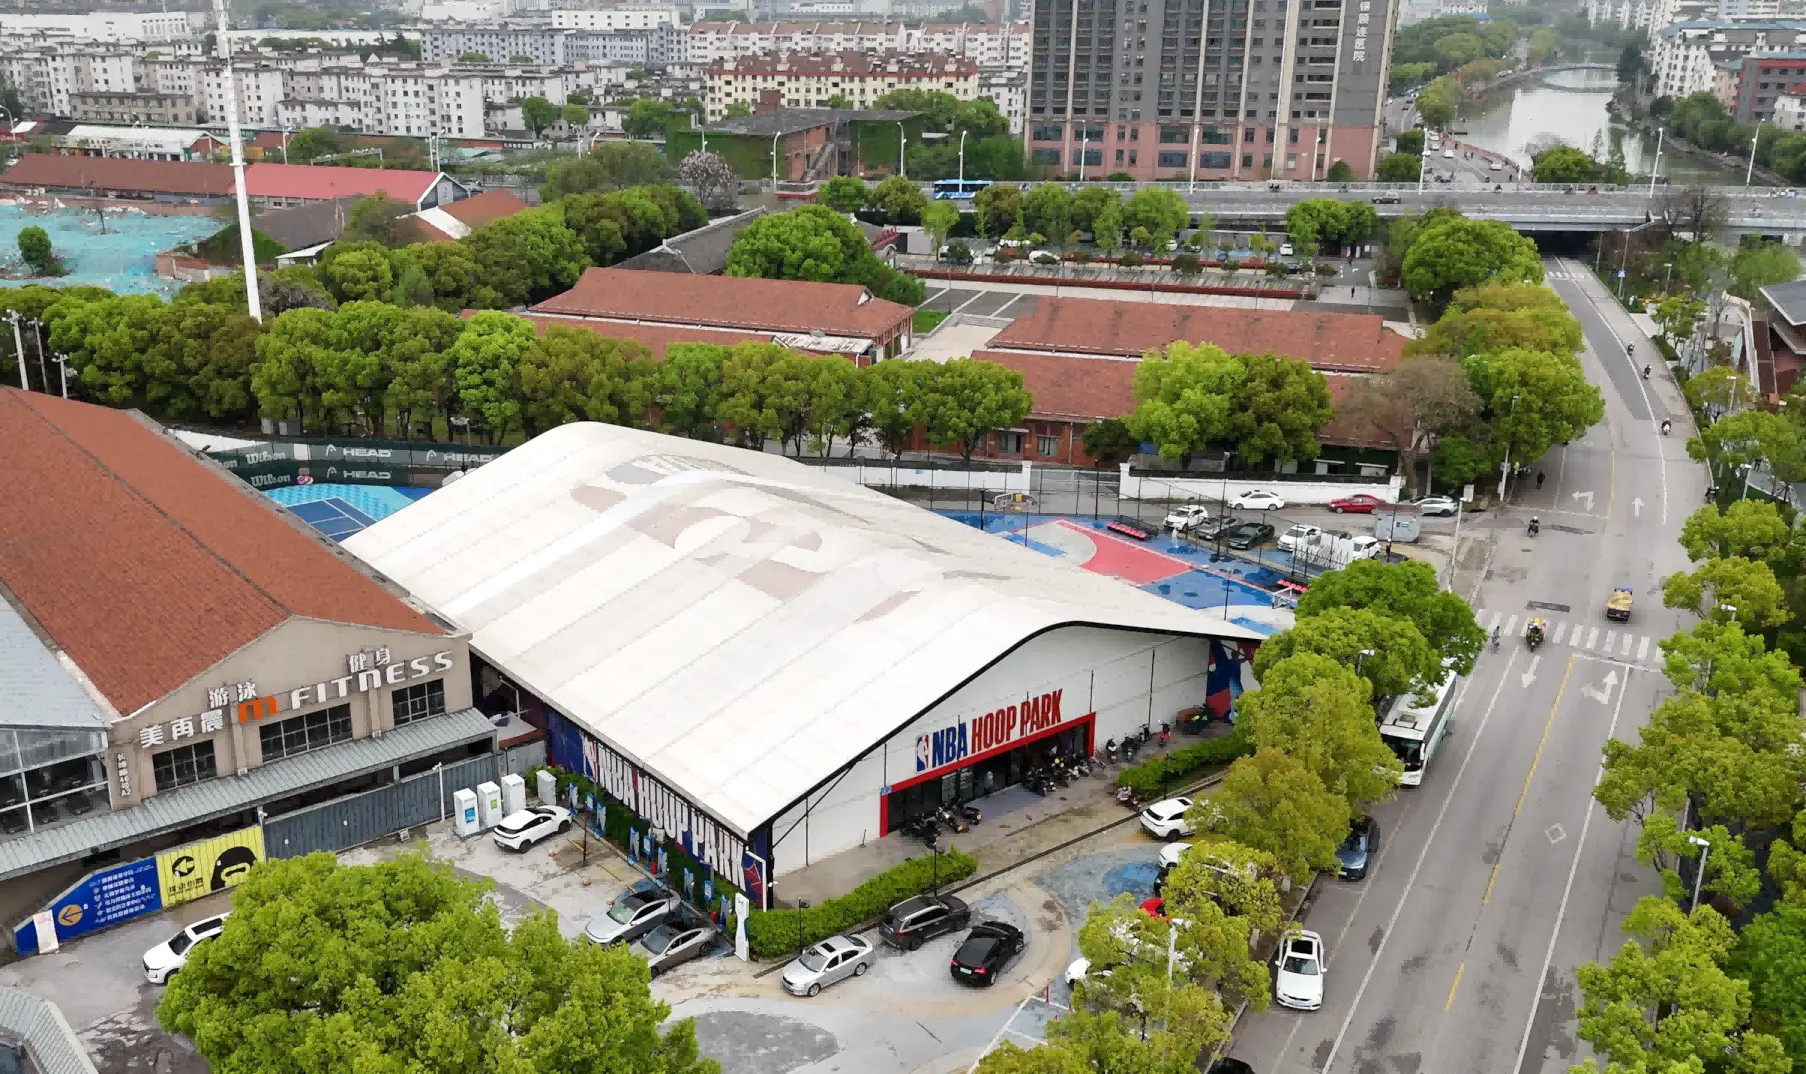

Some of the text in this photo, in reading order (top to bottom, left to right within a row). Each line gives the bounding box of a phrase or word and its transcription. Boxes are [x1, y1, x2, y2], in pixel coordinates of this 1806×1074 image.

[245, 450, 287, 465] Wilson
[343, 448, 392, 458] HEAD
[443, 453, 494, 463] HEAD
[250, 474, 291, 487] Wilson
[343, 470, 392, 480] HEAD
[349, 647, 391, 673] 健身
[139, 708, 224, 749] 美再晨
[290, 650, 453, 710] FITNESS
[208, 681, 257, 709] 游泳
[932, 688, 1063, 768] NBA HOOP PARK
[597, 743, 747, 892] NBA HOOP PARK
